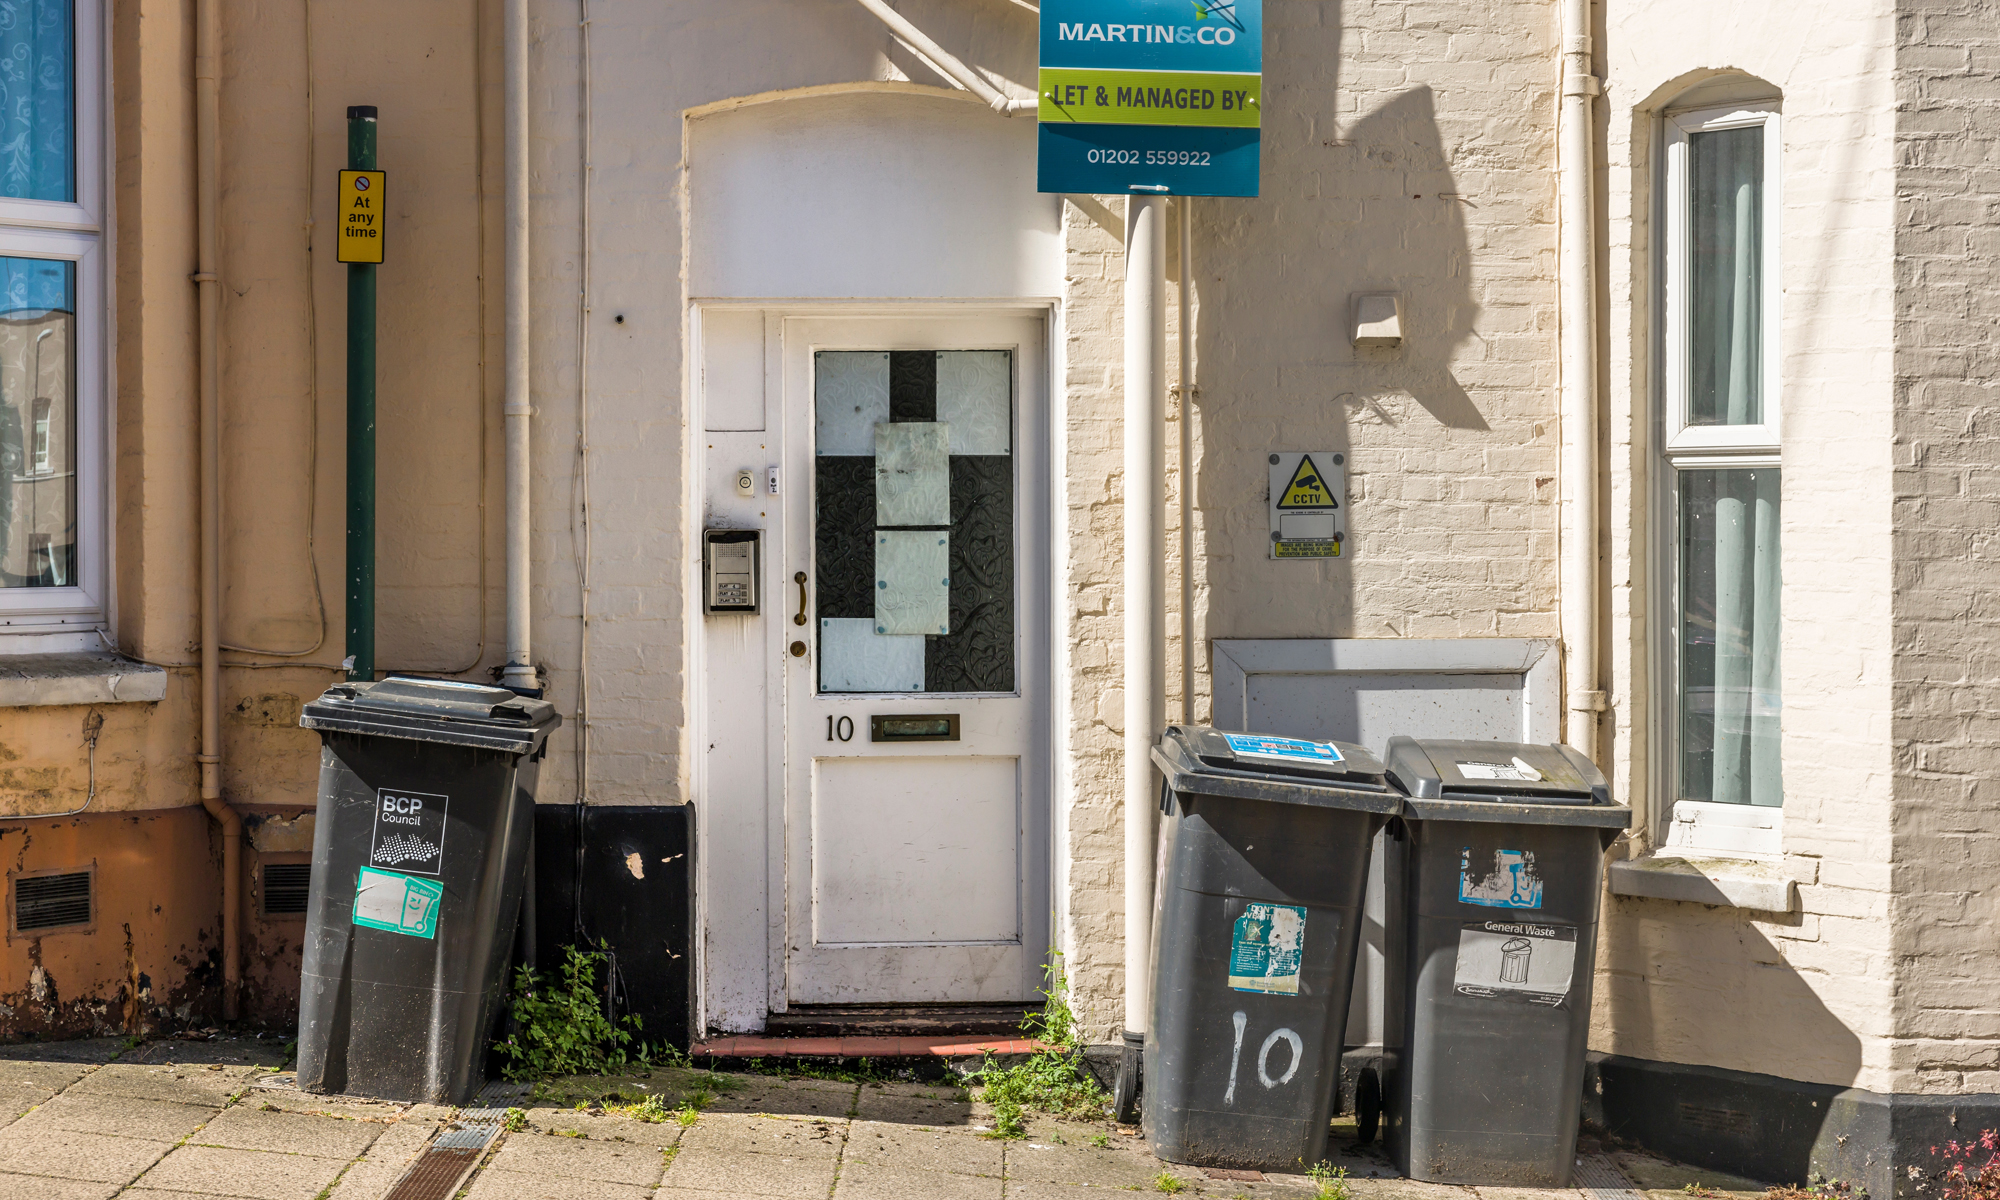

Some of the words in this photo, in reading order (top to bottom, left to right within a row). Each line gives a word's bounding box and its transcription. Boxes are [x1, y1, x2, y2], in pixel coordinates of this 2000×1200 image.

[1059, 22, 1236, 46] MARTIN&CO
[1054, 84, 1089, 106] LET
[1095, 85, 1110, 107] &
[1117, 86, 1215, 110] MANAGED
[1221, 89, 1248, 111] BY
[1087, 148, 1140, 165] 01202
[1145, 150, 1211, 166] 559922
[353, 196, 370, 208] At
[348, 213, 375, 226] any
[345, 226, 377, 238] time
[1293, 494, 1321, 504] CCTV
[826, 714, 855, 742] 10
[382, 795, 423, 815] BCP
[381, 811, 422, 826] Council
[1484, 920, 1524, 934] General
[1525, 925, 1556, 937] Waste
[1224, 1010, 1303, 1107] 10
